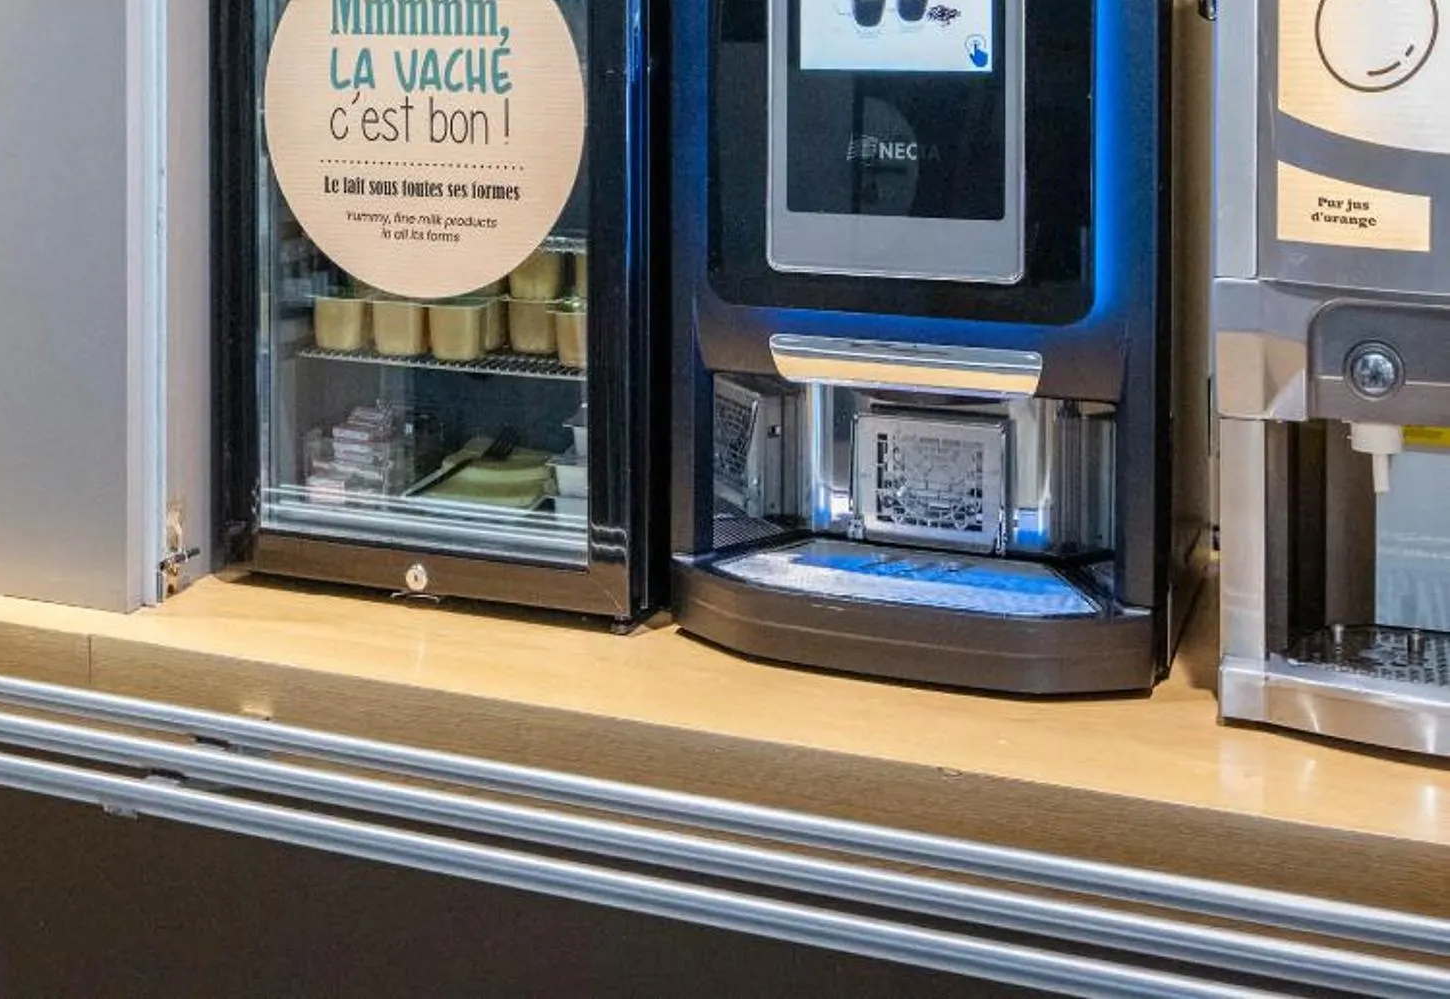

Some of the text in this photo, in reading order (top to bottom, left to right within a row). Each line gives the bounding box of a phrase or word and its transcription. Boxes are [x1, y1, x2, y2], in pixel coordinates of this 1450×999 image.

[330, 47, 375, 90] LA
[330, 91, 510, 145] c'est bon !
[324, 175, 521, 201] Le lait sous toutes ses formes
[1318, 196, 1370, 213] Pur jus
[419, 213, 442, 226] milk
[444, 215, 497, 230] products
[1311, 212, 1377, 228] d'orange
[427, 229, 460, 243] forms
